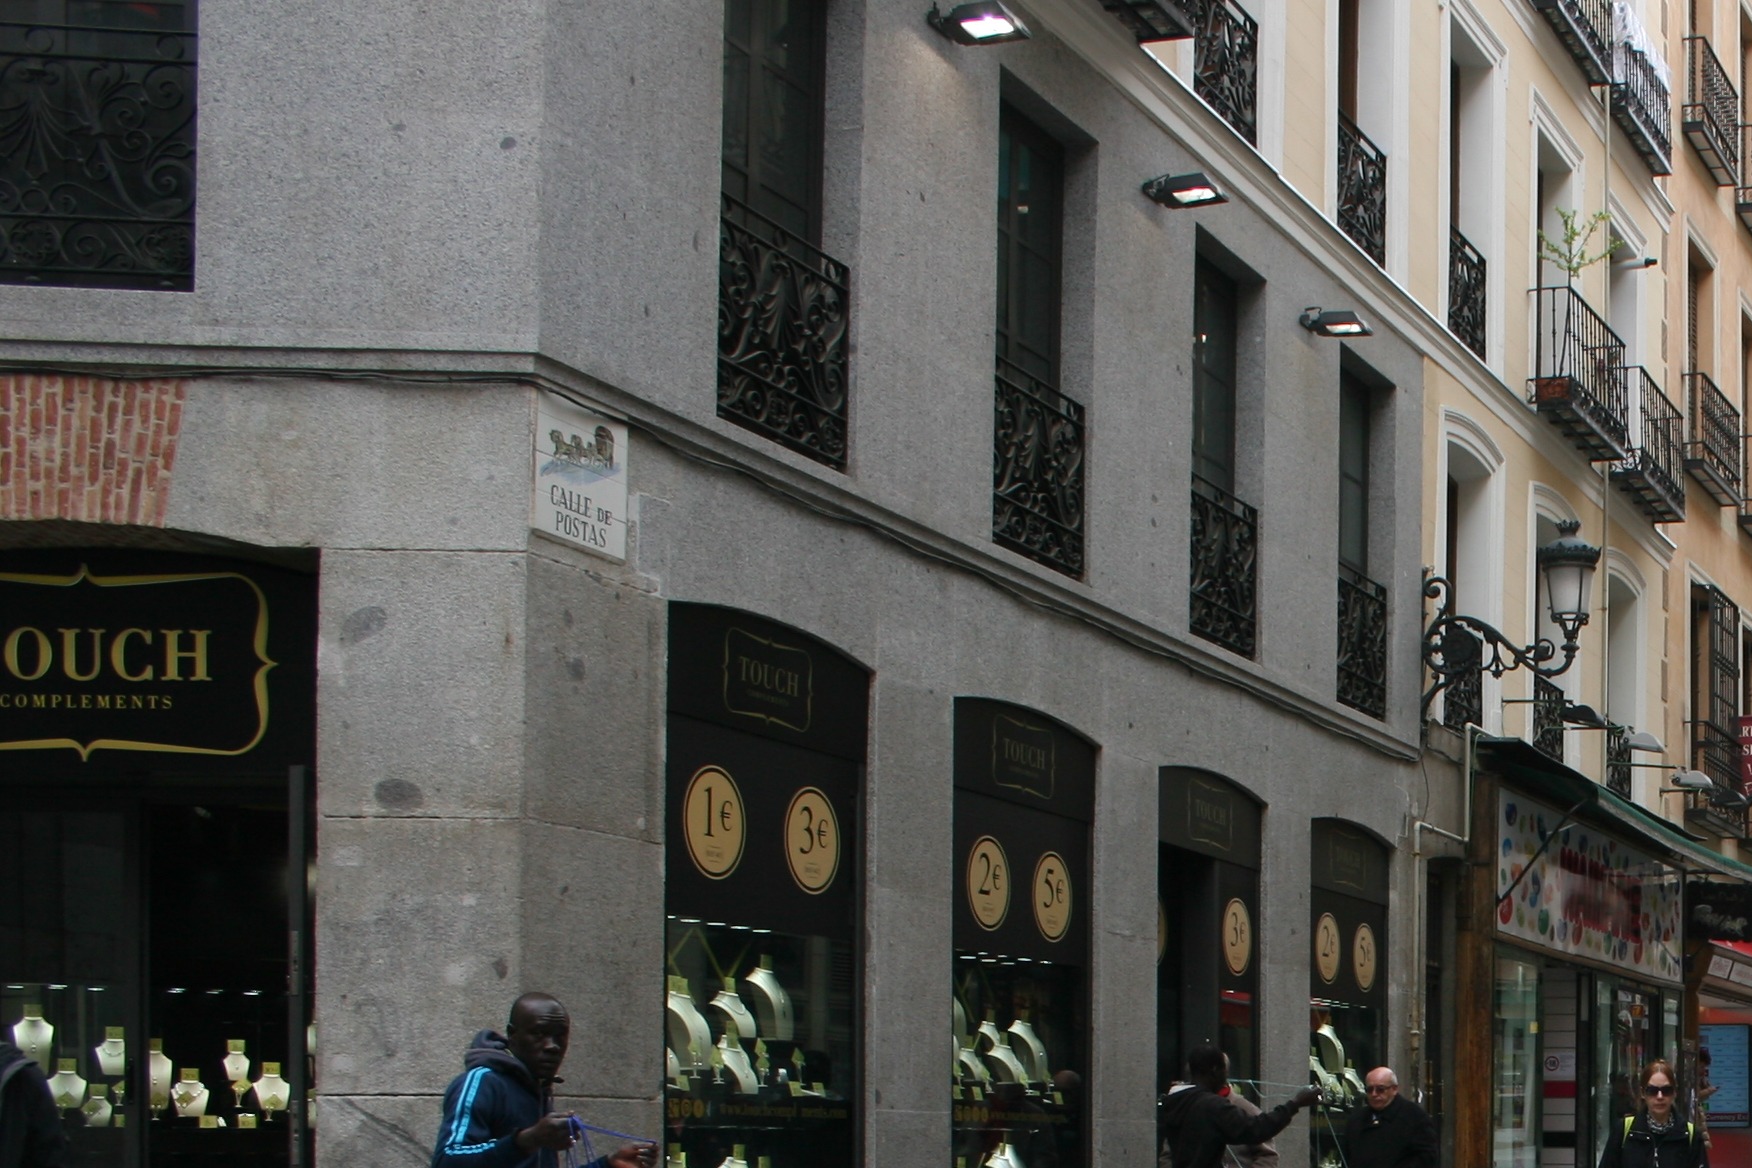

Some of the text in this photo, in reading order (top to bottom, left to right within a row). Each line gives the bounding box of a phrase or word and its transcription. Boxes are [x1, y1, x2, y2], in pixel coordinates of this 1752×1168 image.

[551, 484, 612, 526] CALLE DE
[556, 511, 606, 548] POSTAS
[739, 656, 800, 697] TOUCH
[0, 694, 173, 710] COMPLEMENTS
[1003, 737, 1046, 770] TOUCH
[704, 786, 734, 838] 1€
[800, 806, 828, 854] 3€
[978, 853, 1002, 896] 2€
[1043, 869, 1064, 908] 5€
[1230, 912, 1246, 946] 3€
[1322, 925, 1335, 957] 2€
[1360, 937, 1371, 967] 5€
